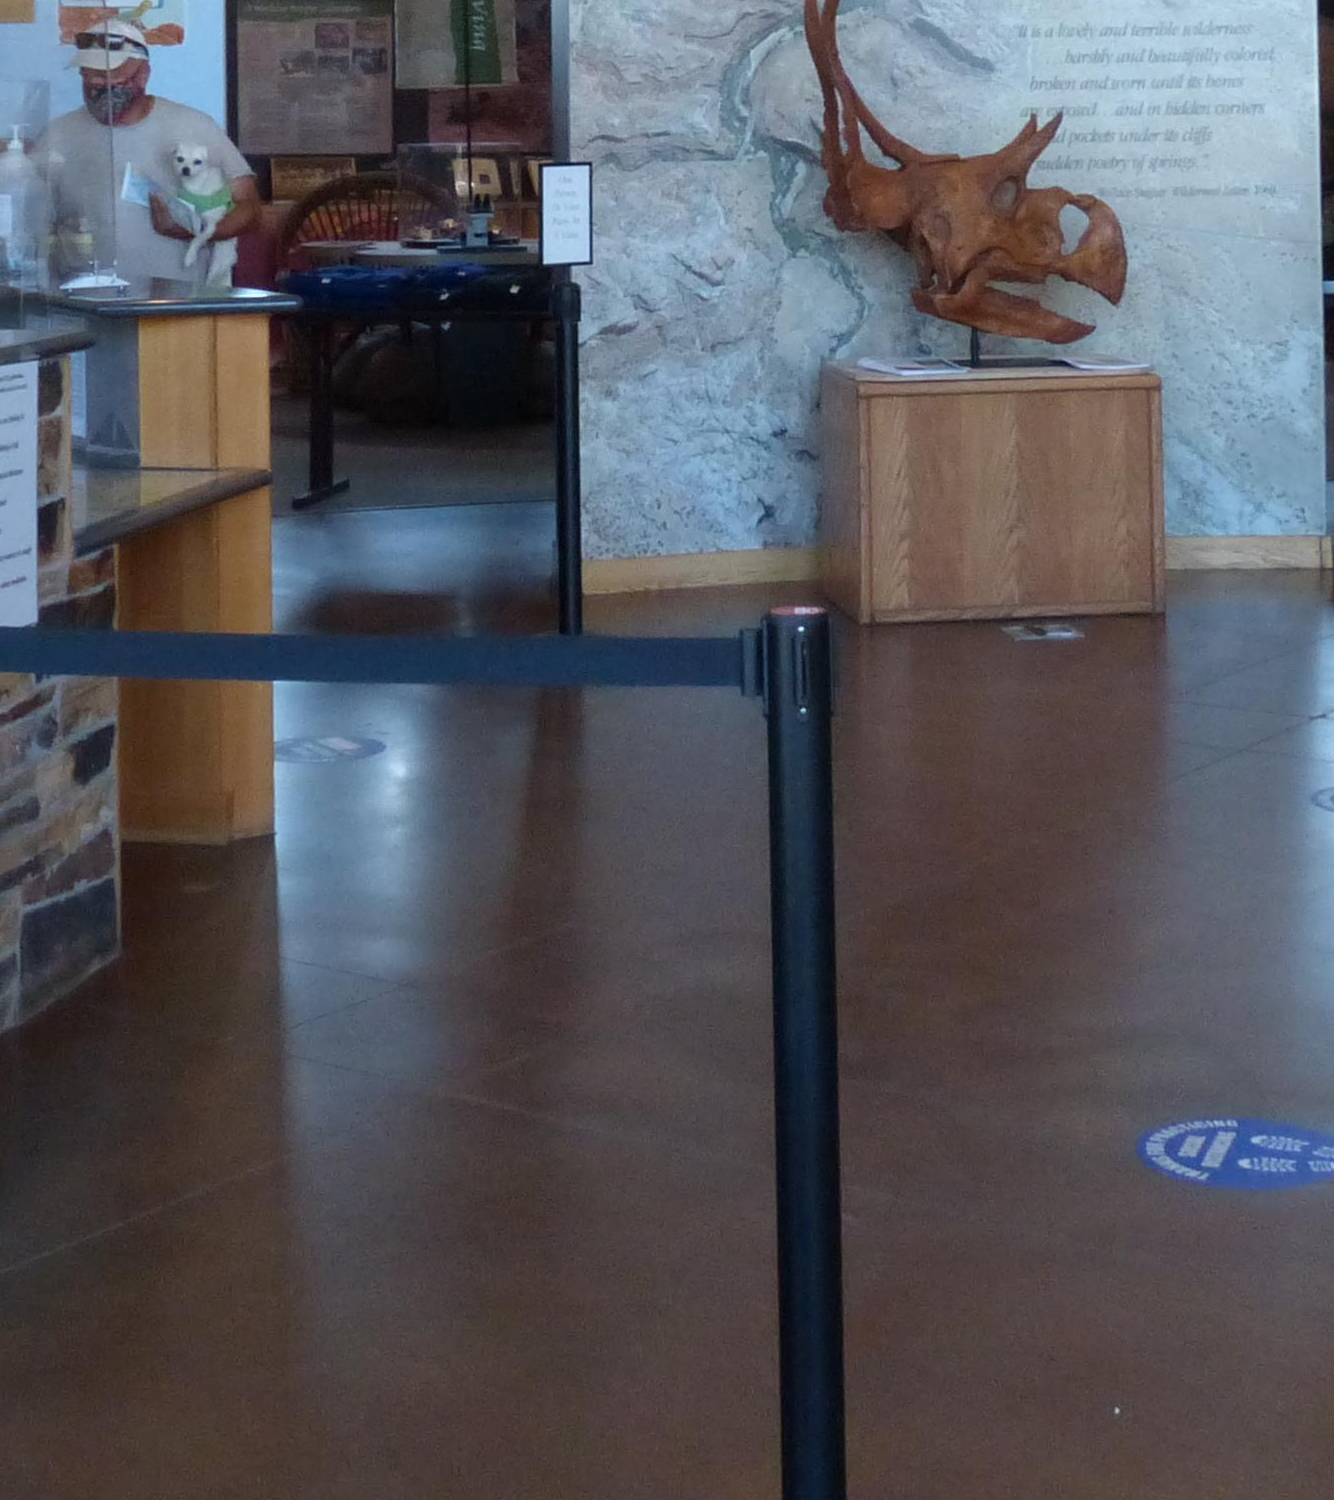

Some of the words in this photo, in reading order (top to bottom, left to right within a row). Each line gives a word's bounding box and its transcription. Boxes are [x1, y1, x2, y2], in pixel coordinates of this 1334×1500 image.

[1098, 22, 1128, 38] and
[1130, 22, 1178, 37] terrible
[1115, 47, 1146, 63] and
[1148, 47, 1220, 67] beautifully
[1029, 75, 1076, 91] broken
[1078, 75, 1109, 91] and
[1114, 101, 1145, 117] and
[1165, 99, 1211, 116] hidden
[1068, 128, 1116, 149] pockets
[1118, 127, 1162, 143] under
